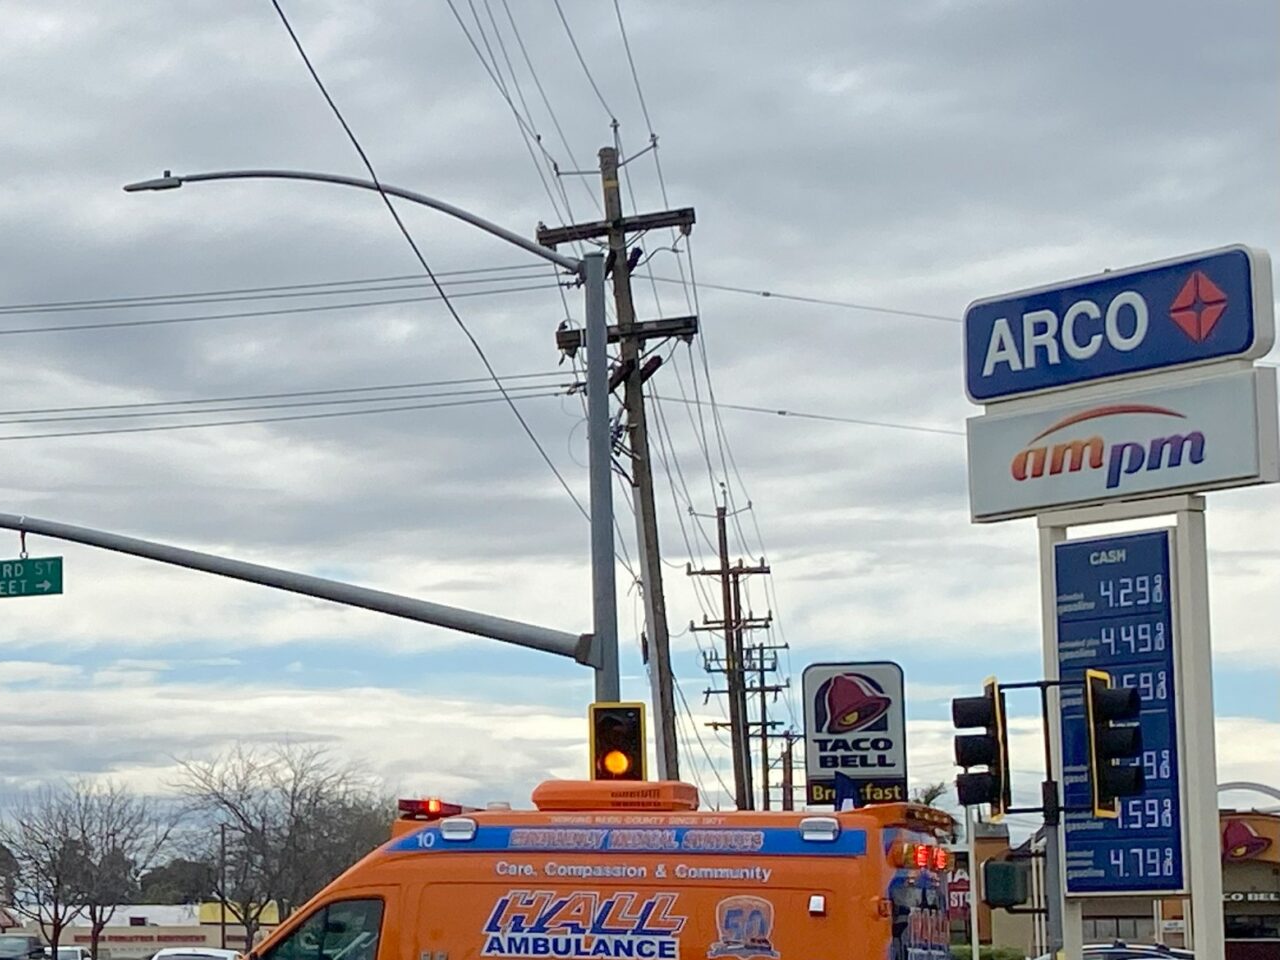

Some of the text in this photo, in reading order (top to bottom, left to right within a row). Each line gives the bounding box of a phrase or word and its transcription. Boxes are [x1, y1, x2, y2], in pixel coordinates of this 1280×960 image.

[982, 290, 1148, 377] ARCO
[1011, 431, 1207, 488] ampm
[1089, 550, 1126, 565] CASH
[35, 561, 54, 575] ST
[812, 738, 893, 752] TACO
[819, 754, 896, 768] BELL
[812, 784, 902, 801] Brfast
[417, 832, 435, 848] 10
[545, 862, 647, 880] Compassion
[655, 865, 667, 878] &
[675, 864, 772, 882] Community
[482, 889, 689, 936] HALL
[485, 936, 677, 959] AMBULANCE
